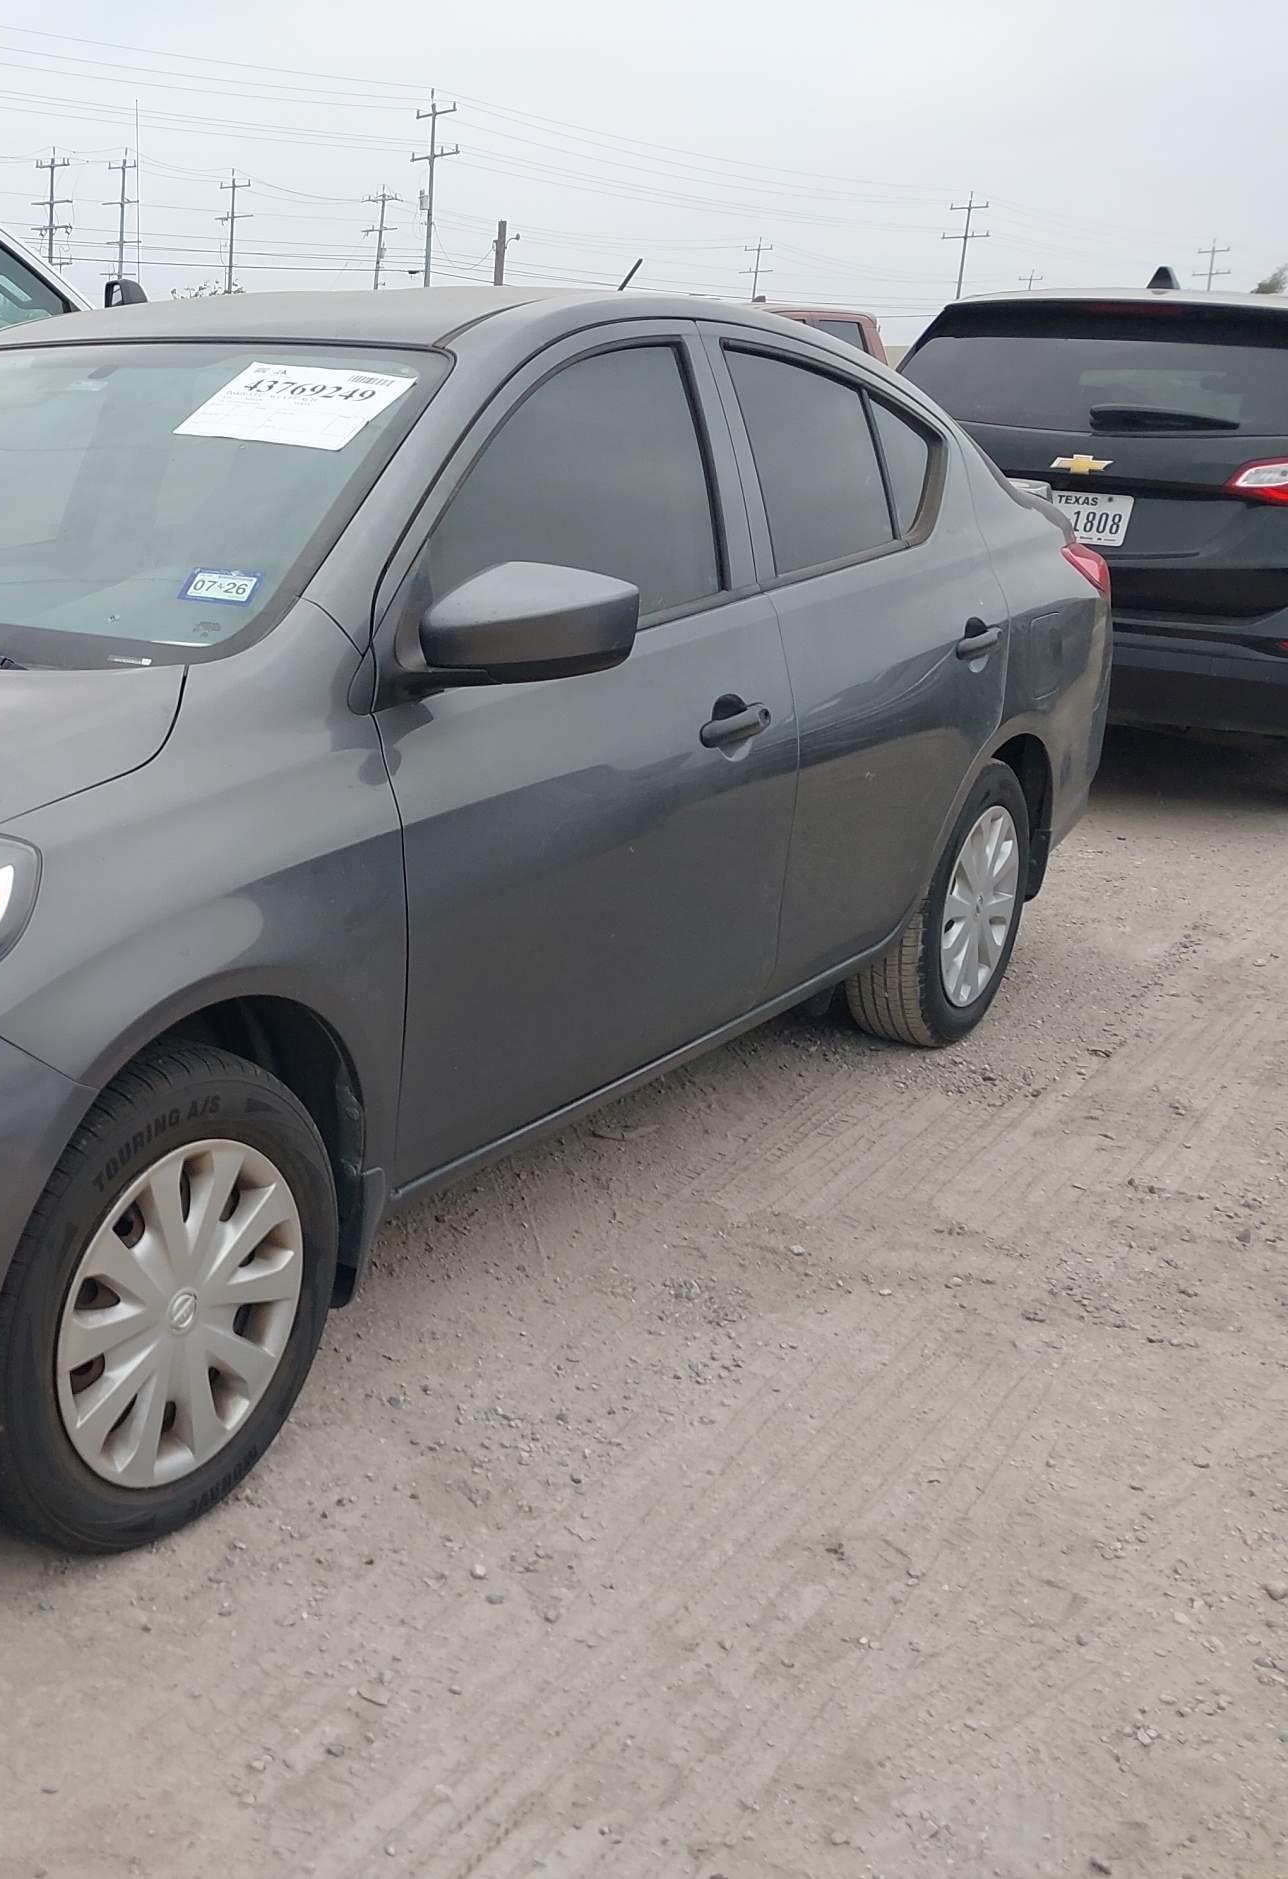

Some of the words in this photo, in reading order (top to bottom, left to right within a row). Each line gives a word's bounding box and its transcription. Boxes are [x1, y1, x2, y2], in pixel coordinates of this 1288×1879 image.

[243, 378, 377, 403] 43769249
[1057, 494, 1099, 506] TEXAS
[92, 1107, 181, 1193] TOURING
[187, 1095, 221, 1120] A/S
